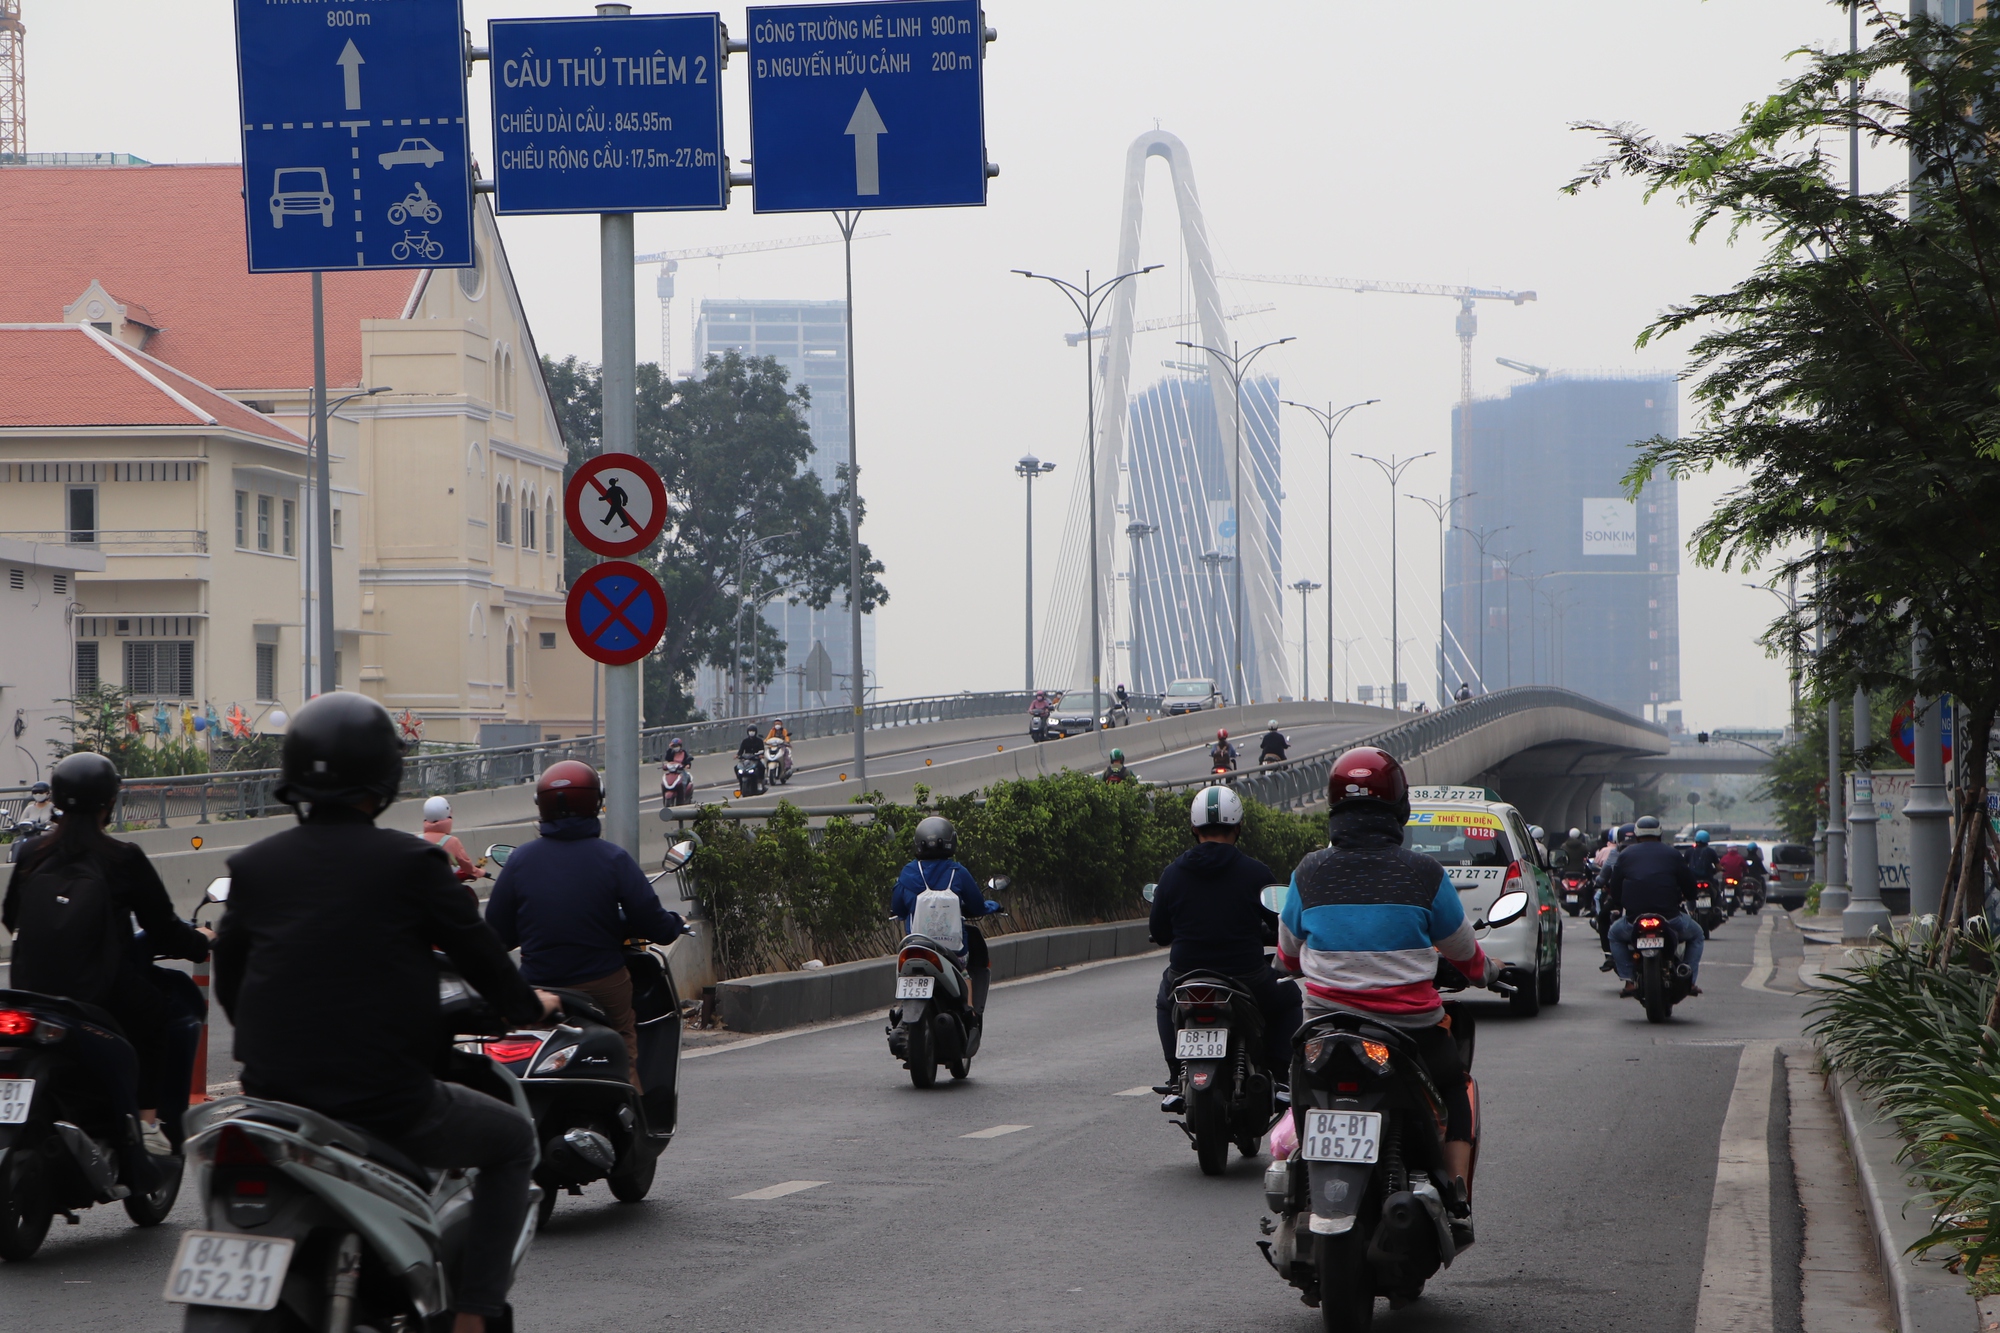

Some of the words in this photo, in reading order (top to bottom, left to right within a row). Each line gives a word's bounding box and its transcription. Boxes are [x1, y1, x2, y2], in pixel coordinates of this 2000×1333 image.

[755, 19, 795, 43] CÔNG
[798, 15, 859, 42] TRƯỜNG
[862, 15, 883, 40] MÊ
[887, 17, 922, 38] LINH
[503, 47, 551, 88] CẦU
[558, 46, 606, 87] THỦ
[612, 49, 687, 86] THIÊM
[694, 55, 708, 85] 2
[835, 50, 866, 76] HỮU
[870, 48, 911, 74] CẢNH
[500, 106, 543, 133] CHIỀU
[547, 107, 572, 133] DÀI
[575, 105, 605, 132] CẦU
[501, 143, 544, 170] CHIỀU
[549, 145, 589, 174] RỘNG
[593, 141, 622, 169] CẦU
[1585, 530, 1635, 542] SONKIM
[1451, 791, 1465, 799] 27
[1468, 791, 1482, 799] 27
[1437, 813, 1460, 823] THIẾT
[1463, 816, 1471, 825] BỊ
[1473, 816, 1493, 825] ĐIỆN
[1466, 827, 1495, 838] 10126
[1448, 869, 1462, 878] 27
[1466, 869, 1480, 879] 27
[1484, 870, 1498, 879] 27
[903, 978, 928, 988] 36-R8
[903, 988, 928, 997] 1455
[1185, 1031, 1218, 1043] 68-T1
[1180, 1044, 1223, 1056] 225.88
[1317, 1114, 1367, 1136] 84-B1
[1308, 1136, 1374, 1159] 185.72
[194, 1238, 271, 1271] 84-K1
[173, 1268, 272, 1304] 052.31
